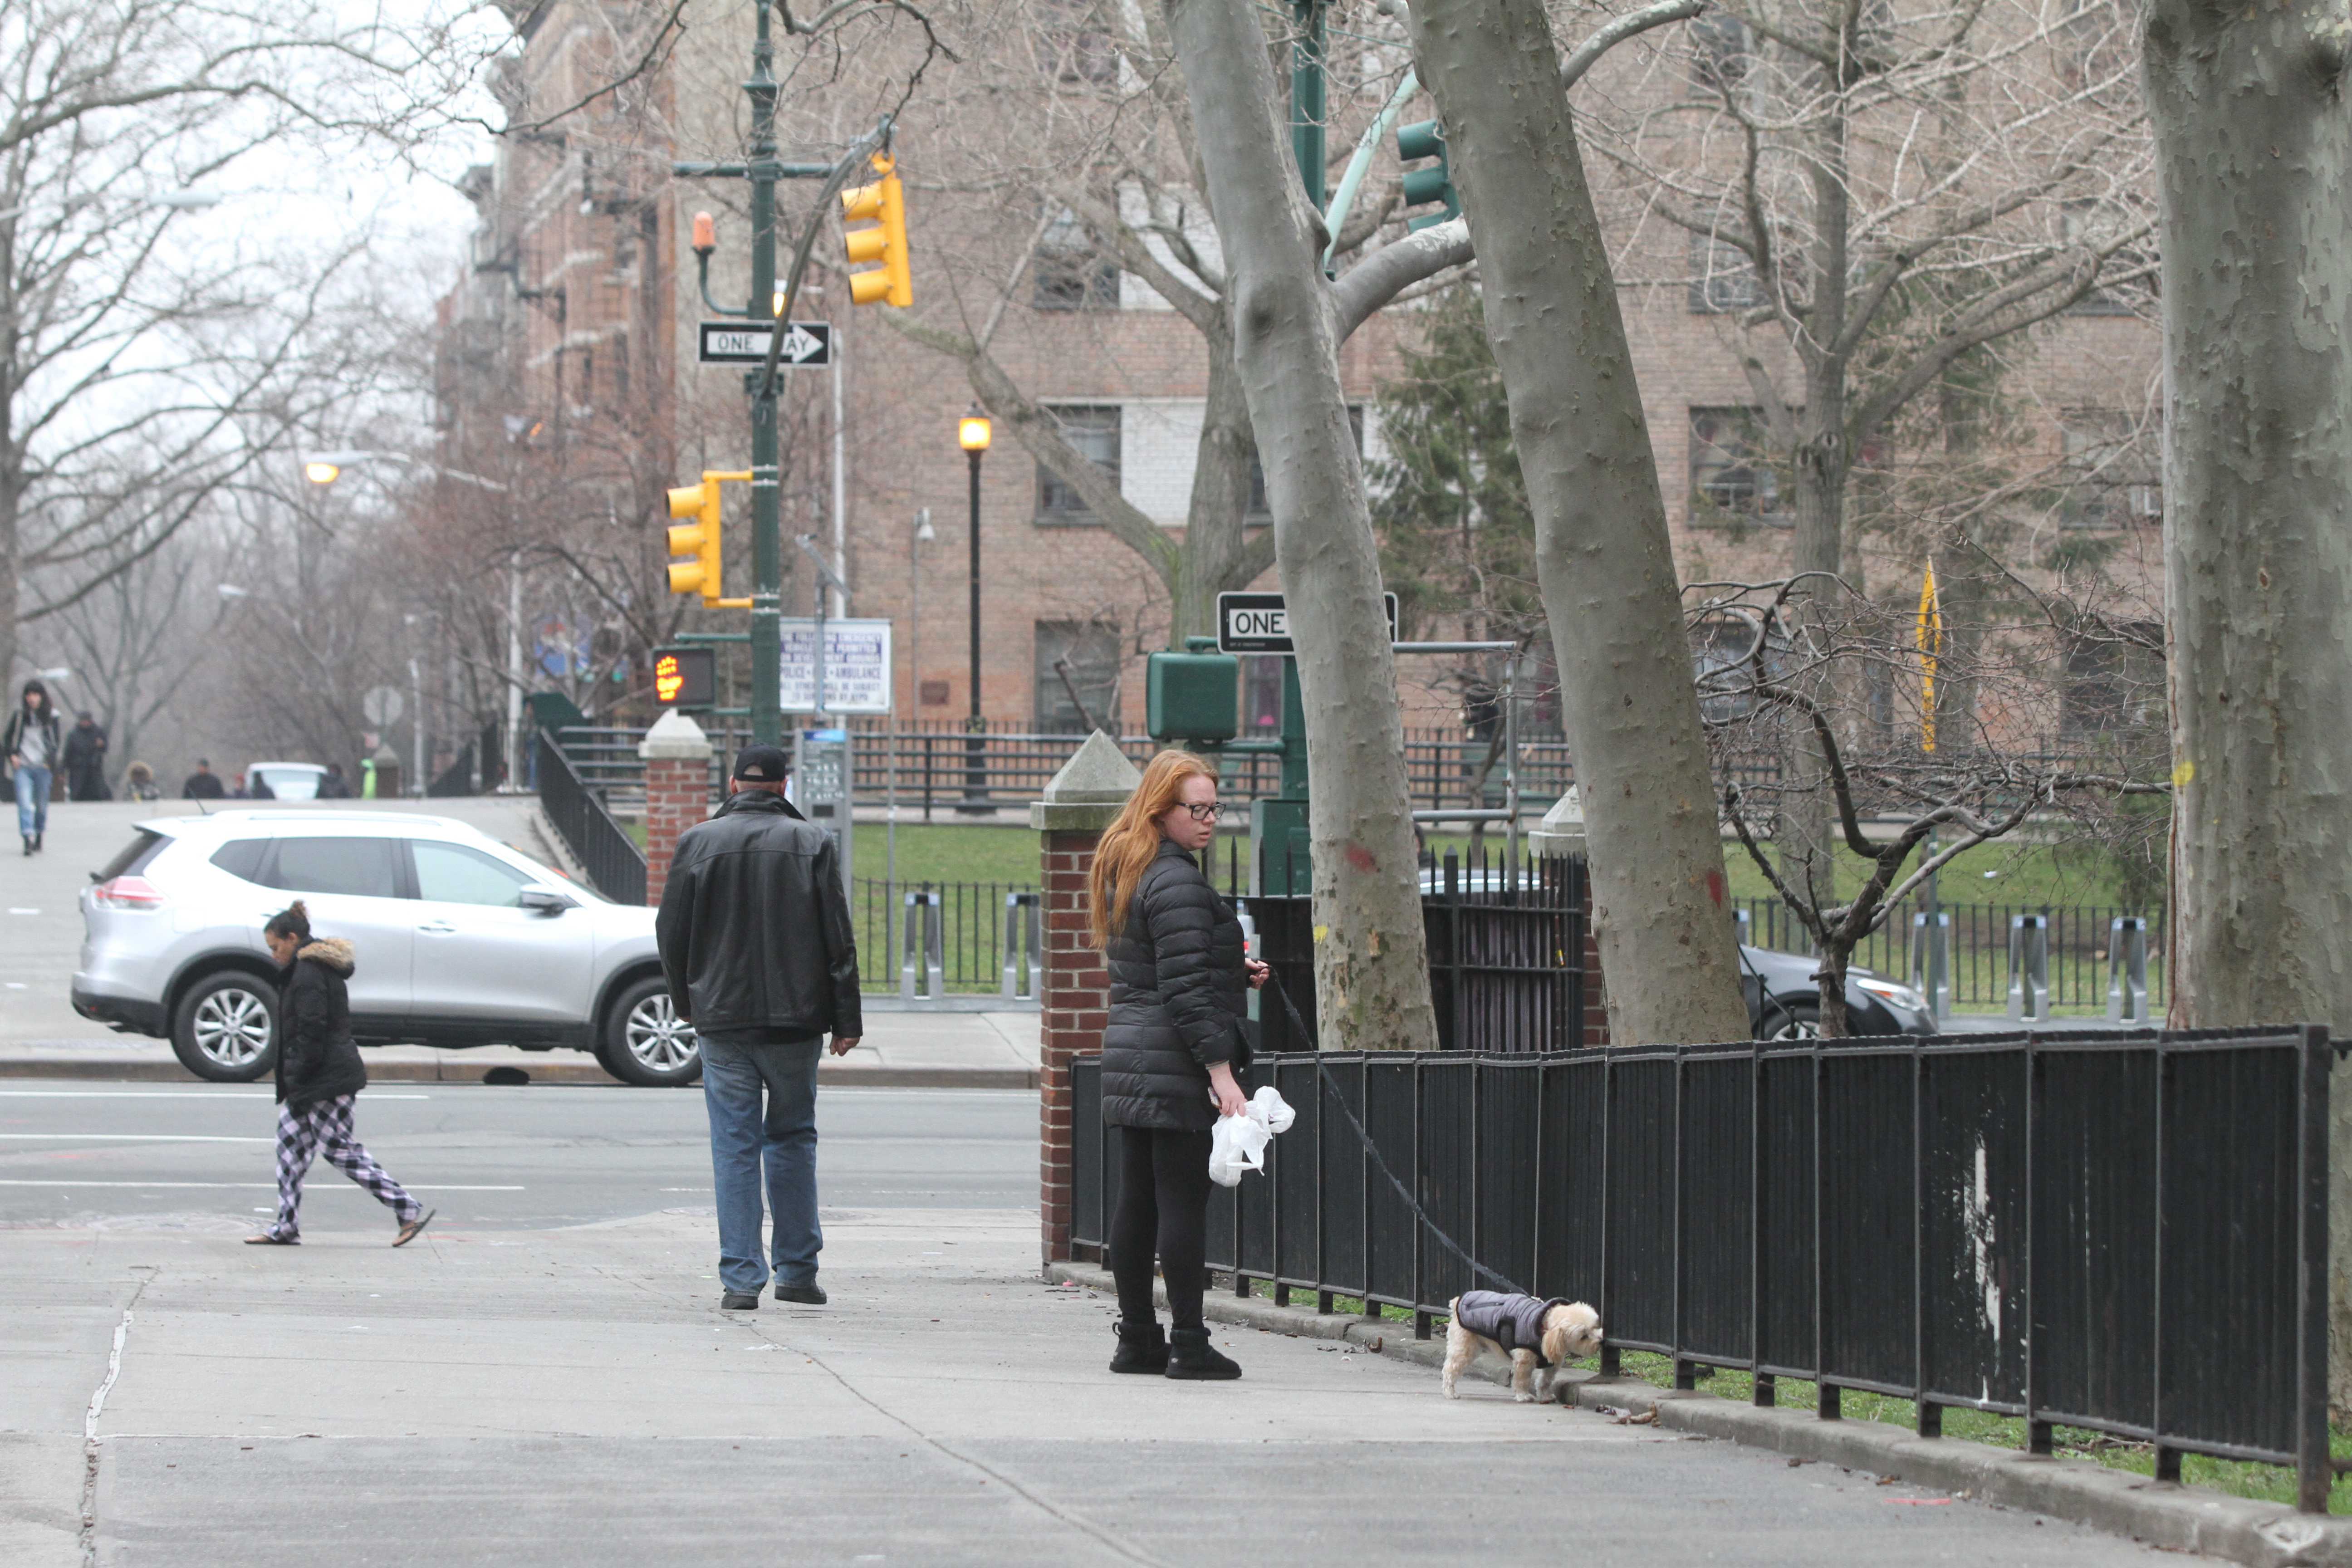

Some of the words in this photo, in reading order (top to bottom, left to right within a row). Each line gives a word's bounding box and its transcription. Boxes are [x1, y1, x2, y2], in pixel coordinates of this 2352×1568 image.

[718, 334, 754, 351] ONE
[786, 336, 809, 352] AY
[1235, 612, 1285, 633] ONE
